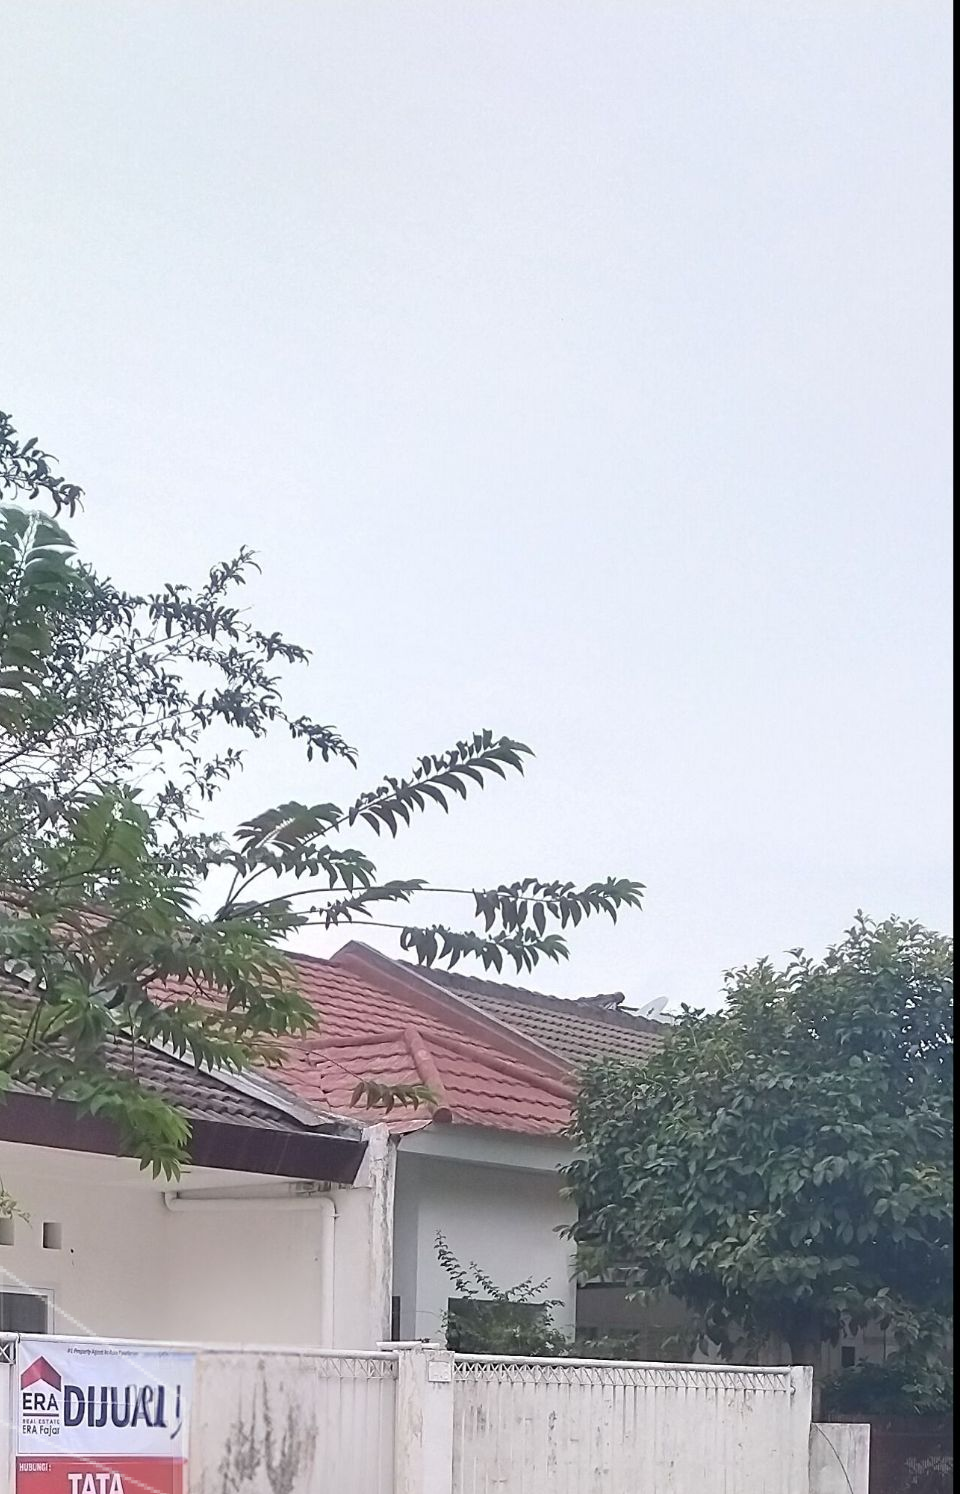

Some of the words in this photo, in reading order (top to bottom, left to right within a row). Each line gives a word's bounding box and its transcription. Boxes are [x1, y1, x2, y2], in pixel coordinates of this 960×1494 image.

[22, 1392, 59, 1411] ERA
[22, 1424, 38, 1435] ERA
[39, 1424, 60, 1437] Fajar
